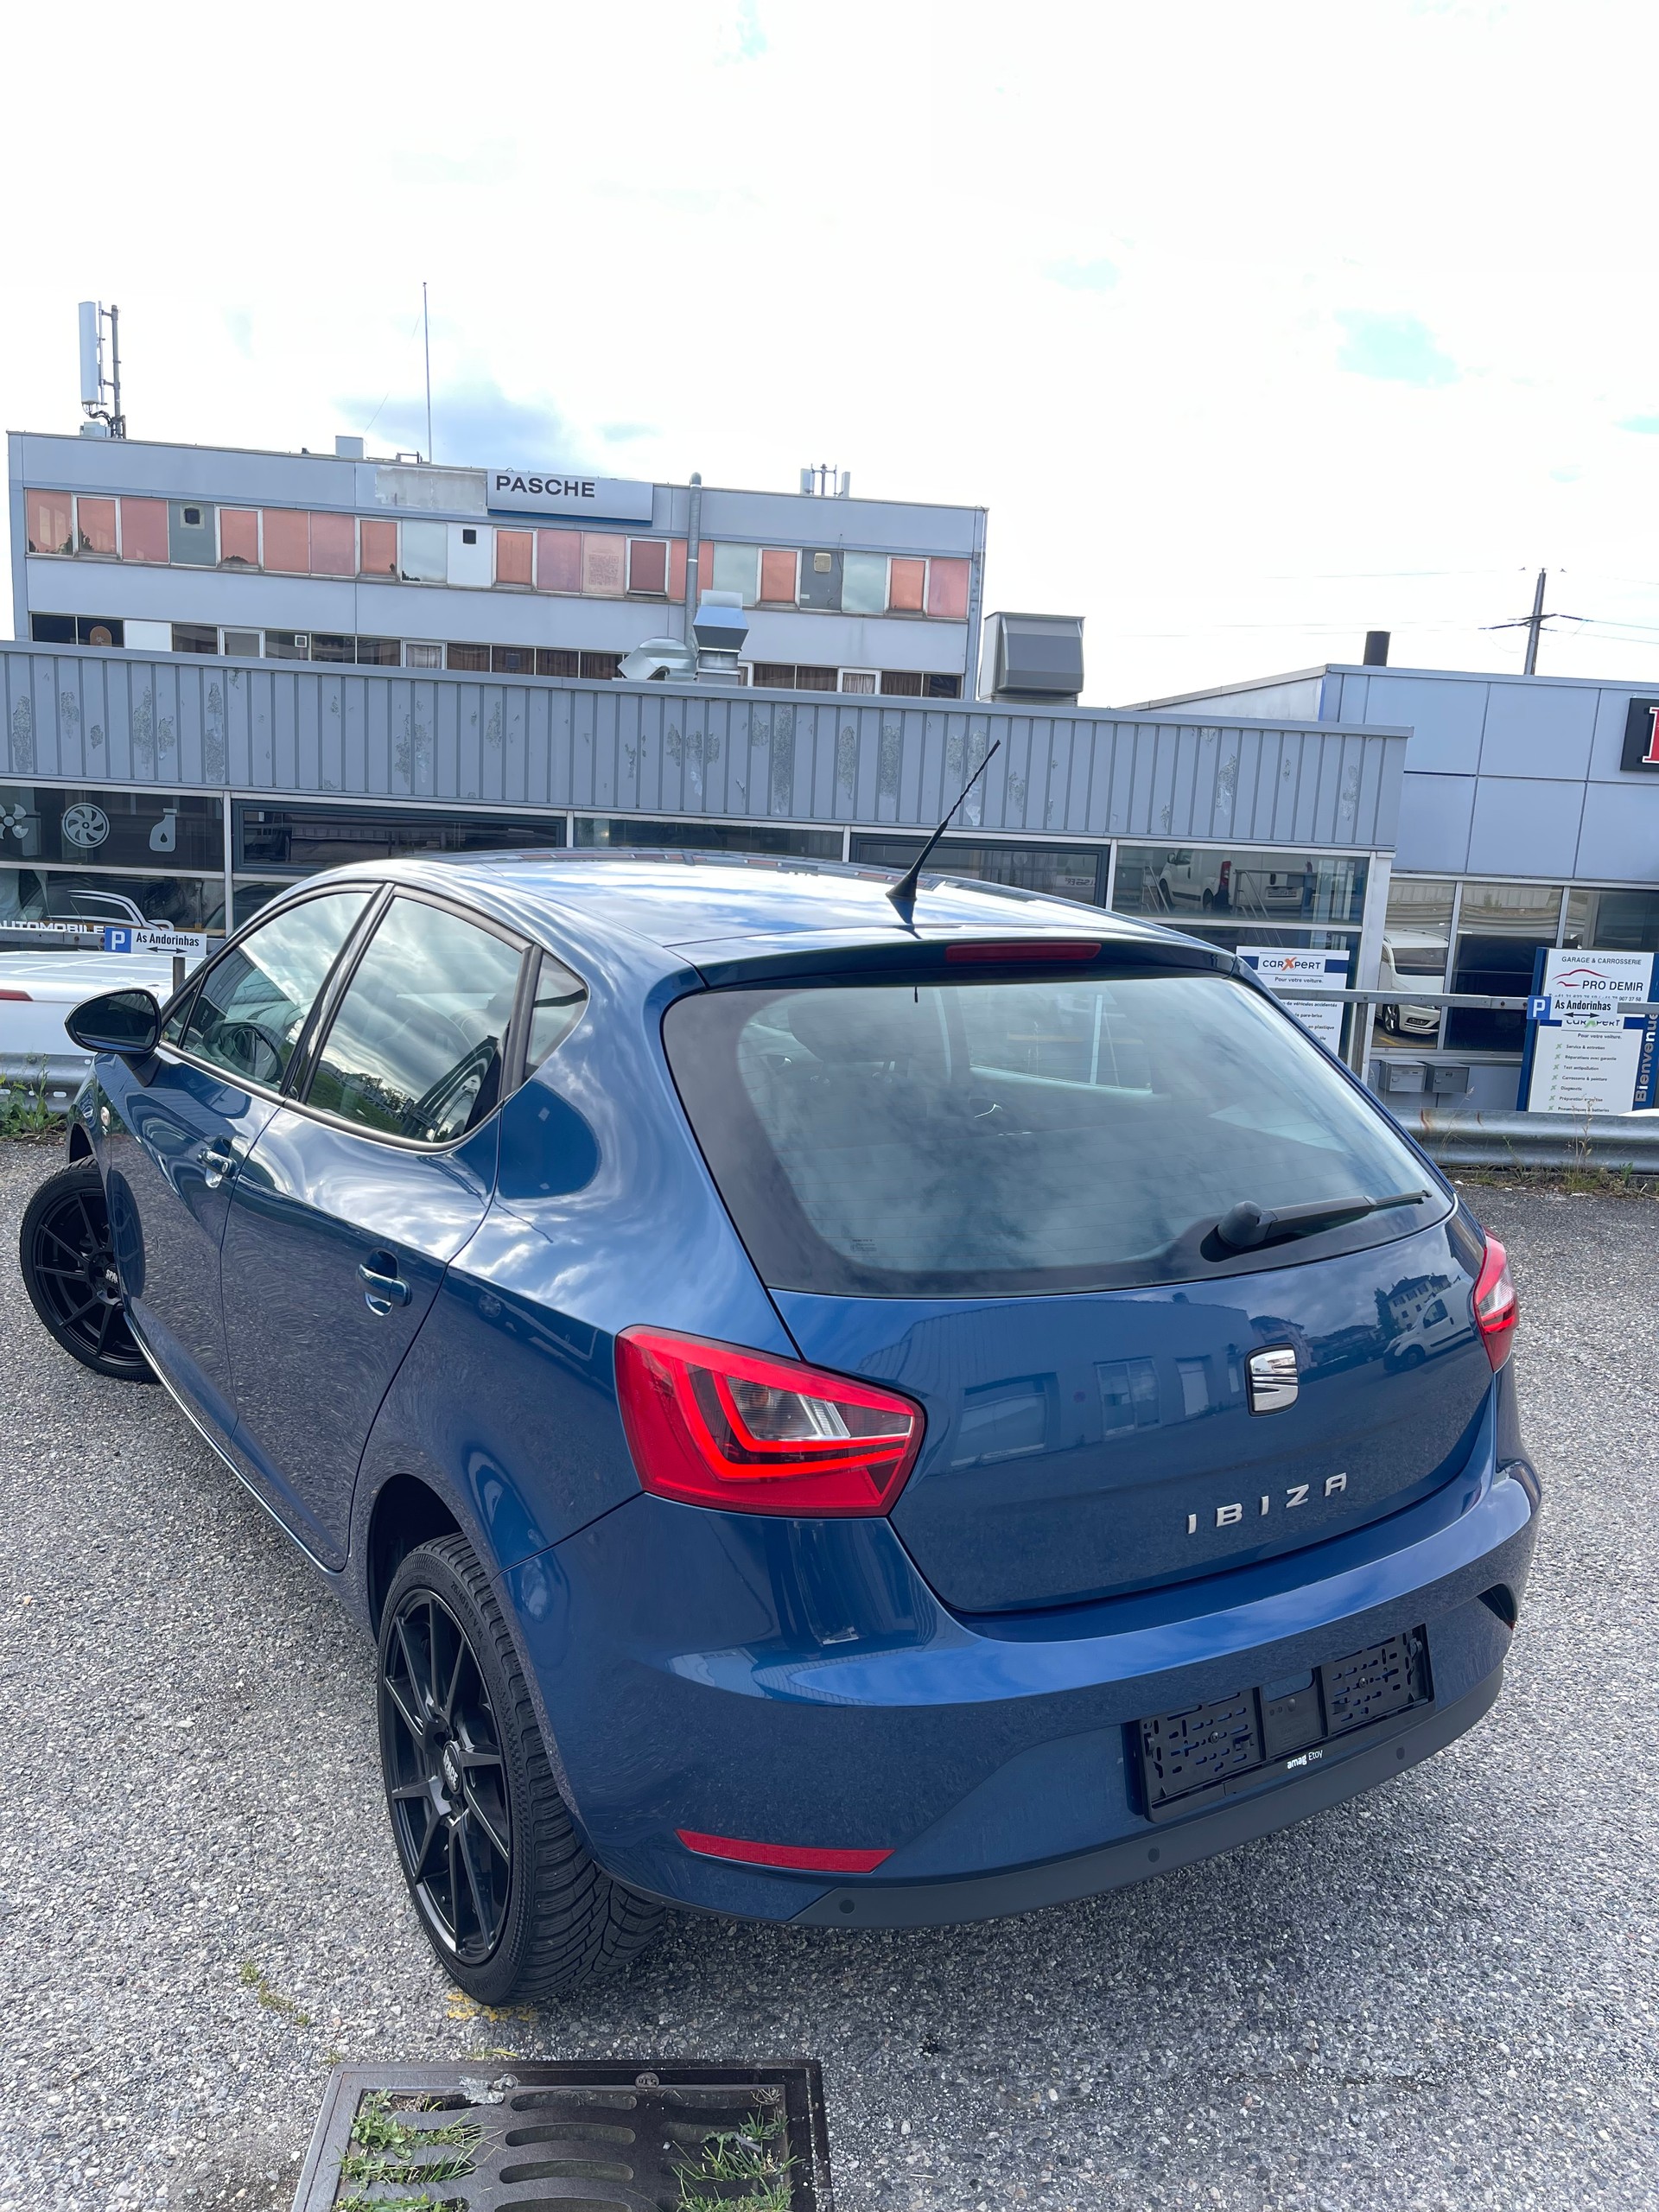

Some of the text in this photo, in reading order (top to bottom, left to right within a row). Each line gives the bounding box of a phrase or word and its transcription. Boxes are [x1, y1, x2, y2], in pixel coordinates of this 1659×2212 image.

[496, 475, 595, 498] PASCHE
[0, 920, 106, 933] UTOMOBILE
[111, 931, 125, 950] P
[136, 931, 200, 947] As Andorinhas
[1582, 980, 1643, 992] PRO DEMIR
[1533, 999, 1545, 1017] P
[1554, 1000, 1611, 1011] As Andorinhas
[1635, 1014, 1659, 1102] Bienvenue
[1187, 1471, 1347, 1535] IBIZA
[1287, 1750, 1323, 1770] amag Etoy
